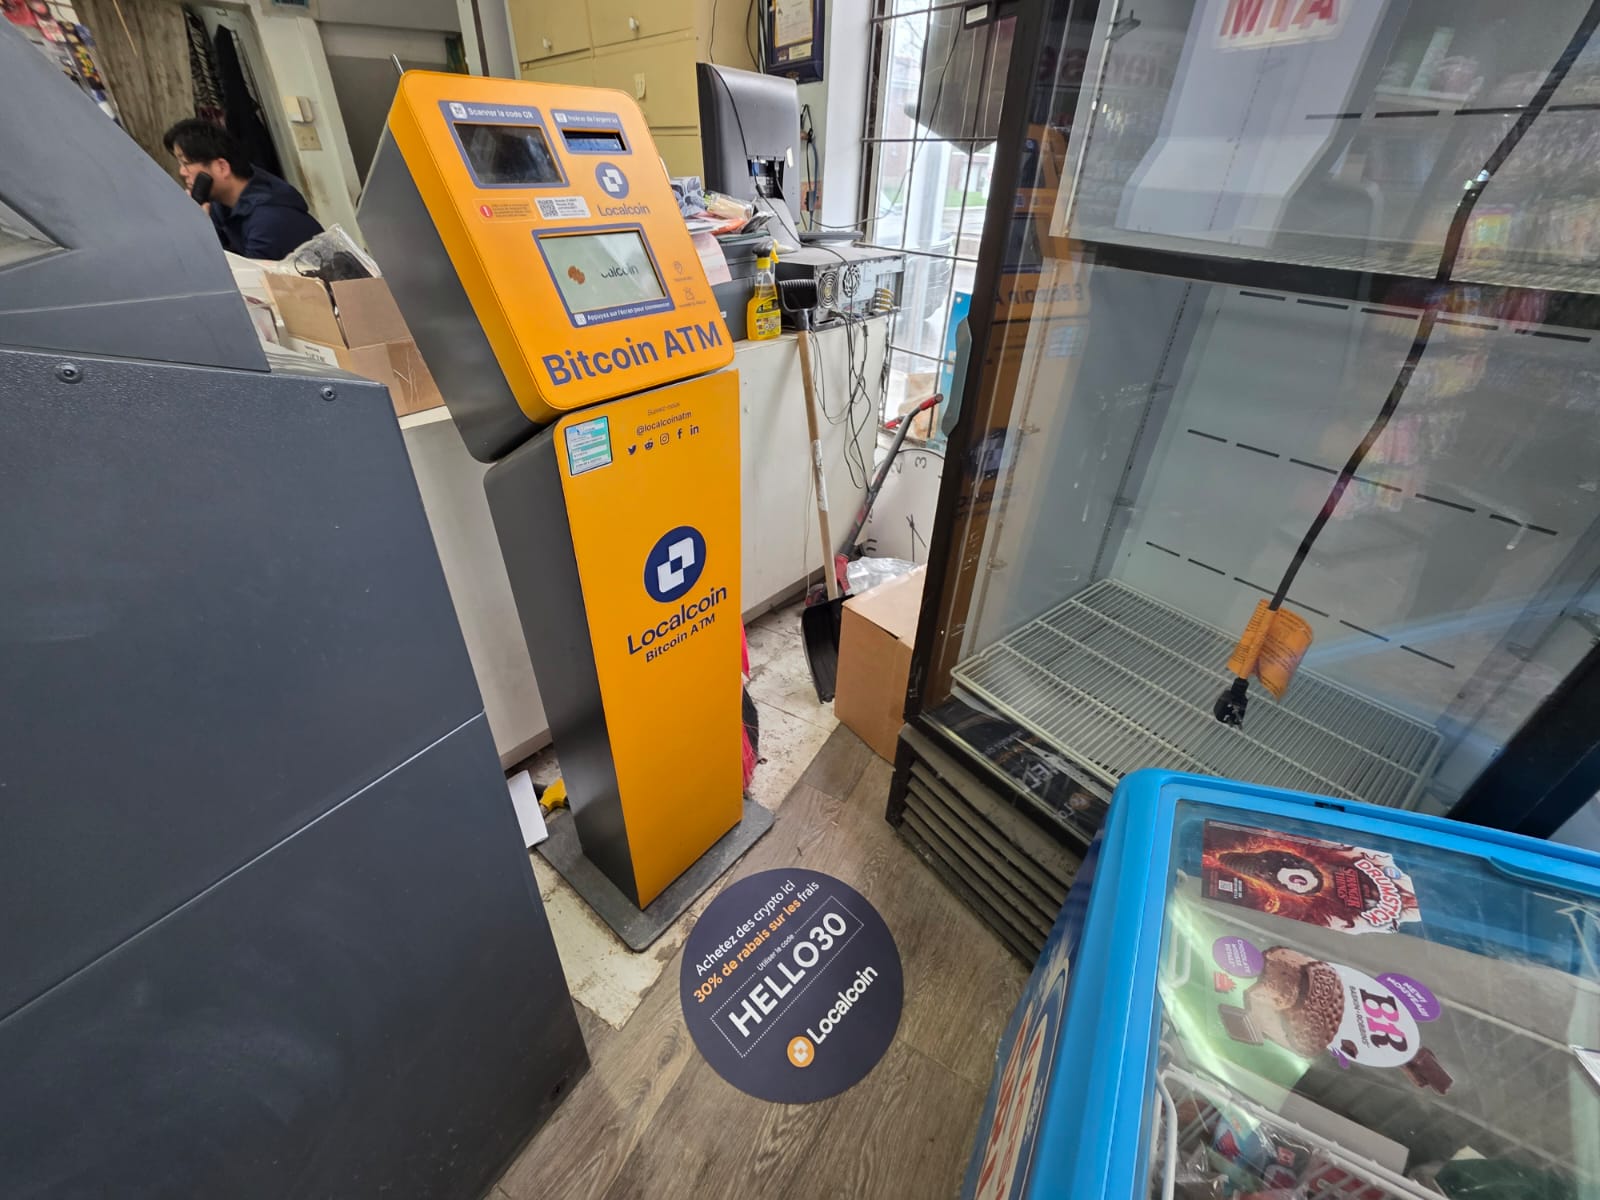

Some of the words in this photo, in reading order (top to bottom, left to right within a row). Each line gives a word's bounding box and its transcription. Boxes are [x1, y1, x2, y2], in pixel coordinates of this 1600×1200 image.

[468, 107, 496, 117] Scanner
[523, 111, 534, 119] QR
[597, 203, 650, 217] Localcoin
[587, 311, 609, 322] Appuyez
[634, 306, 644, 314] pour
[542, 337, 659, 386] Bitcoin
[664, 321, 724, 358] ATM
[636, 411, 692, 436] @localcoinatm
[914, 456, 928, 469] 3
[627, 586, 727, 655] Localcoin
[646, 631, 688, 663] Bitcoin
[690, 613, 716, 637] ATM
[1336, 871, 1347, 900] THINGS
[1344, 868, 1362, 908] STRANGER
[1356, 860, 1400, 925] DRUMSTICK
[693, 972, 724, 1004] 30%
[721, 958, 739, 977] de
[736, 929, 771, 963] rabais
[768, 912, 788, 932] sur
[785, 898, 802, 917] les
[797, 880, 820, 904] frais
[695, 934, 739, 977] Achetez
[736, 918, 756, 939] des
[753, 893, 784, 923] crypto
[780, 879, 797, 896] ici
[728, 912, 847, 1038] HELLO30
[756, 949, 779, 972] Utiliser
[781, 933, 795, 948] code
[806, 964, 879, 1045] Localcoin
